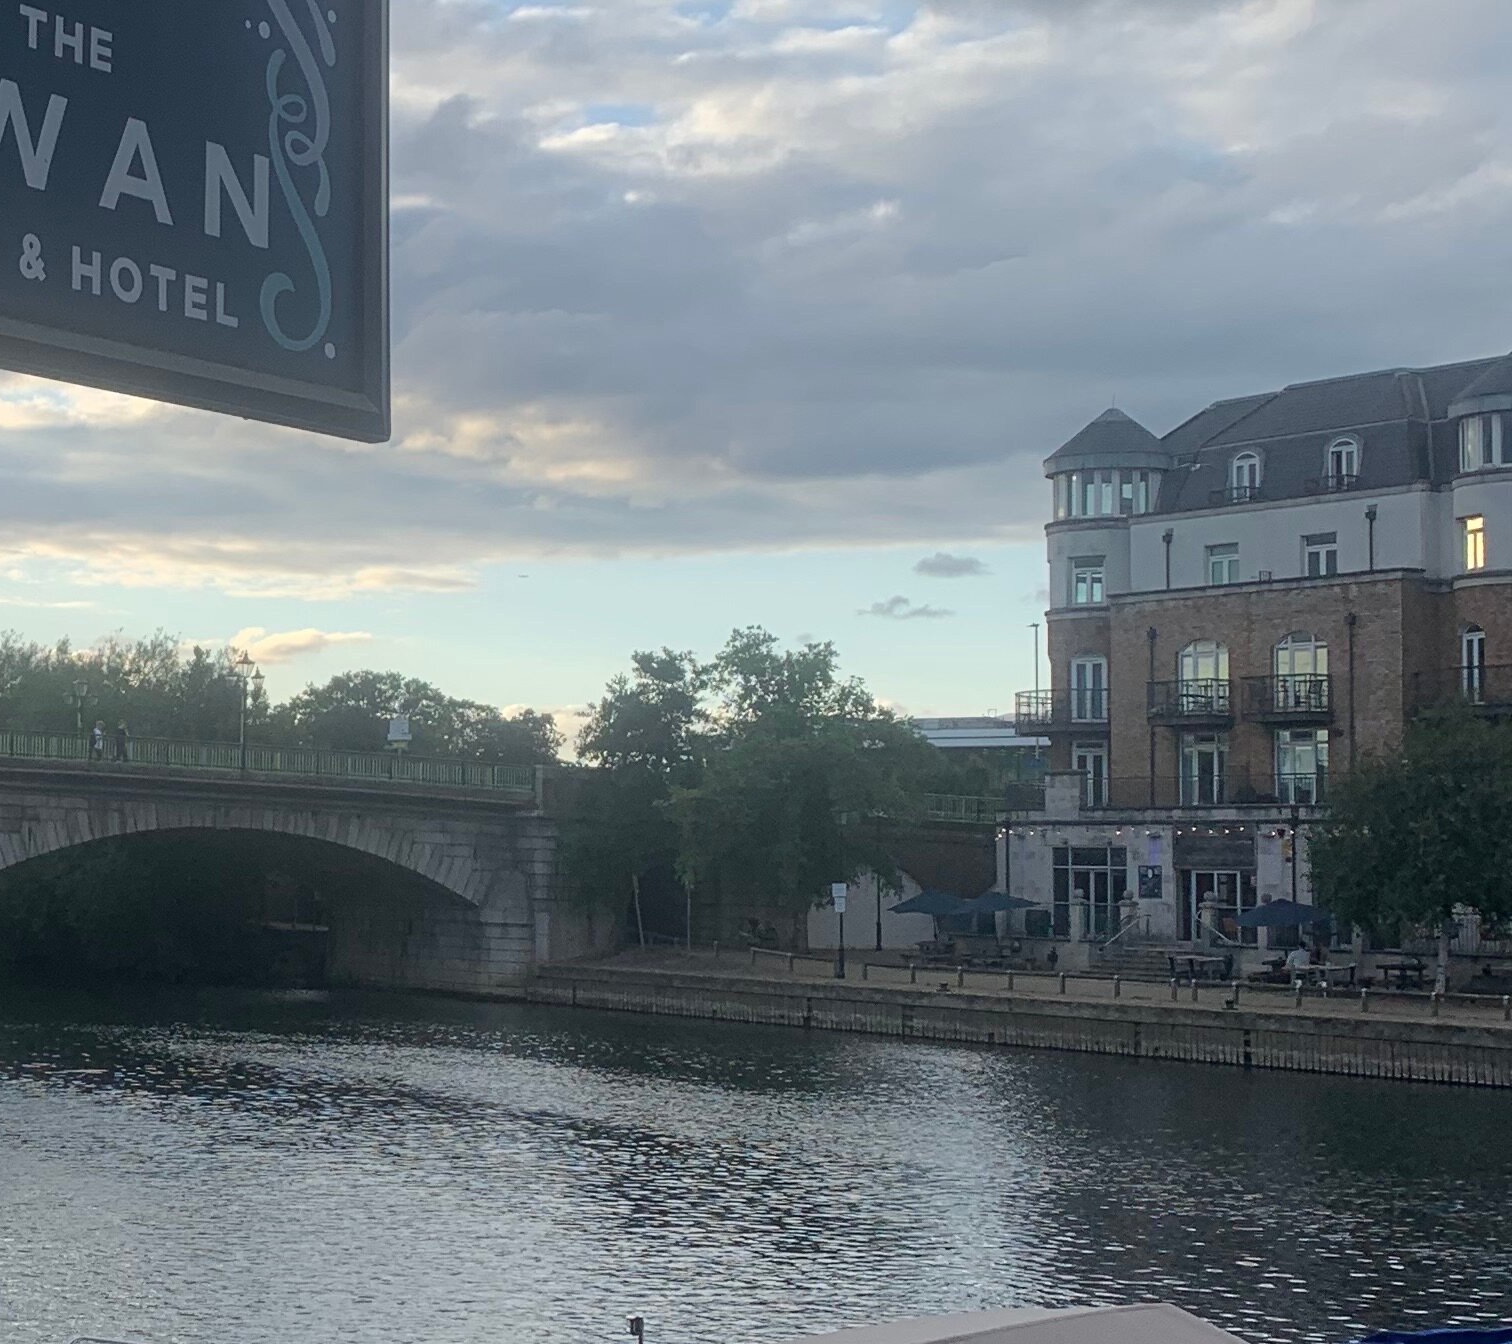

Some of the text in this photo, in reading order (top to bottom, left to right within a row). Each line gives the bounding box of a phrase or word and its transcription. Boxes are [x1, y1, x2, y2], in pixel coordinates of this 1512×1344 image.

[19, 3, 113, 73] THE
[19, 232, 46, 282] &
[71, 245, 239, 328] HOTEL
